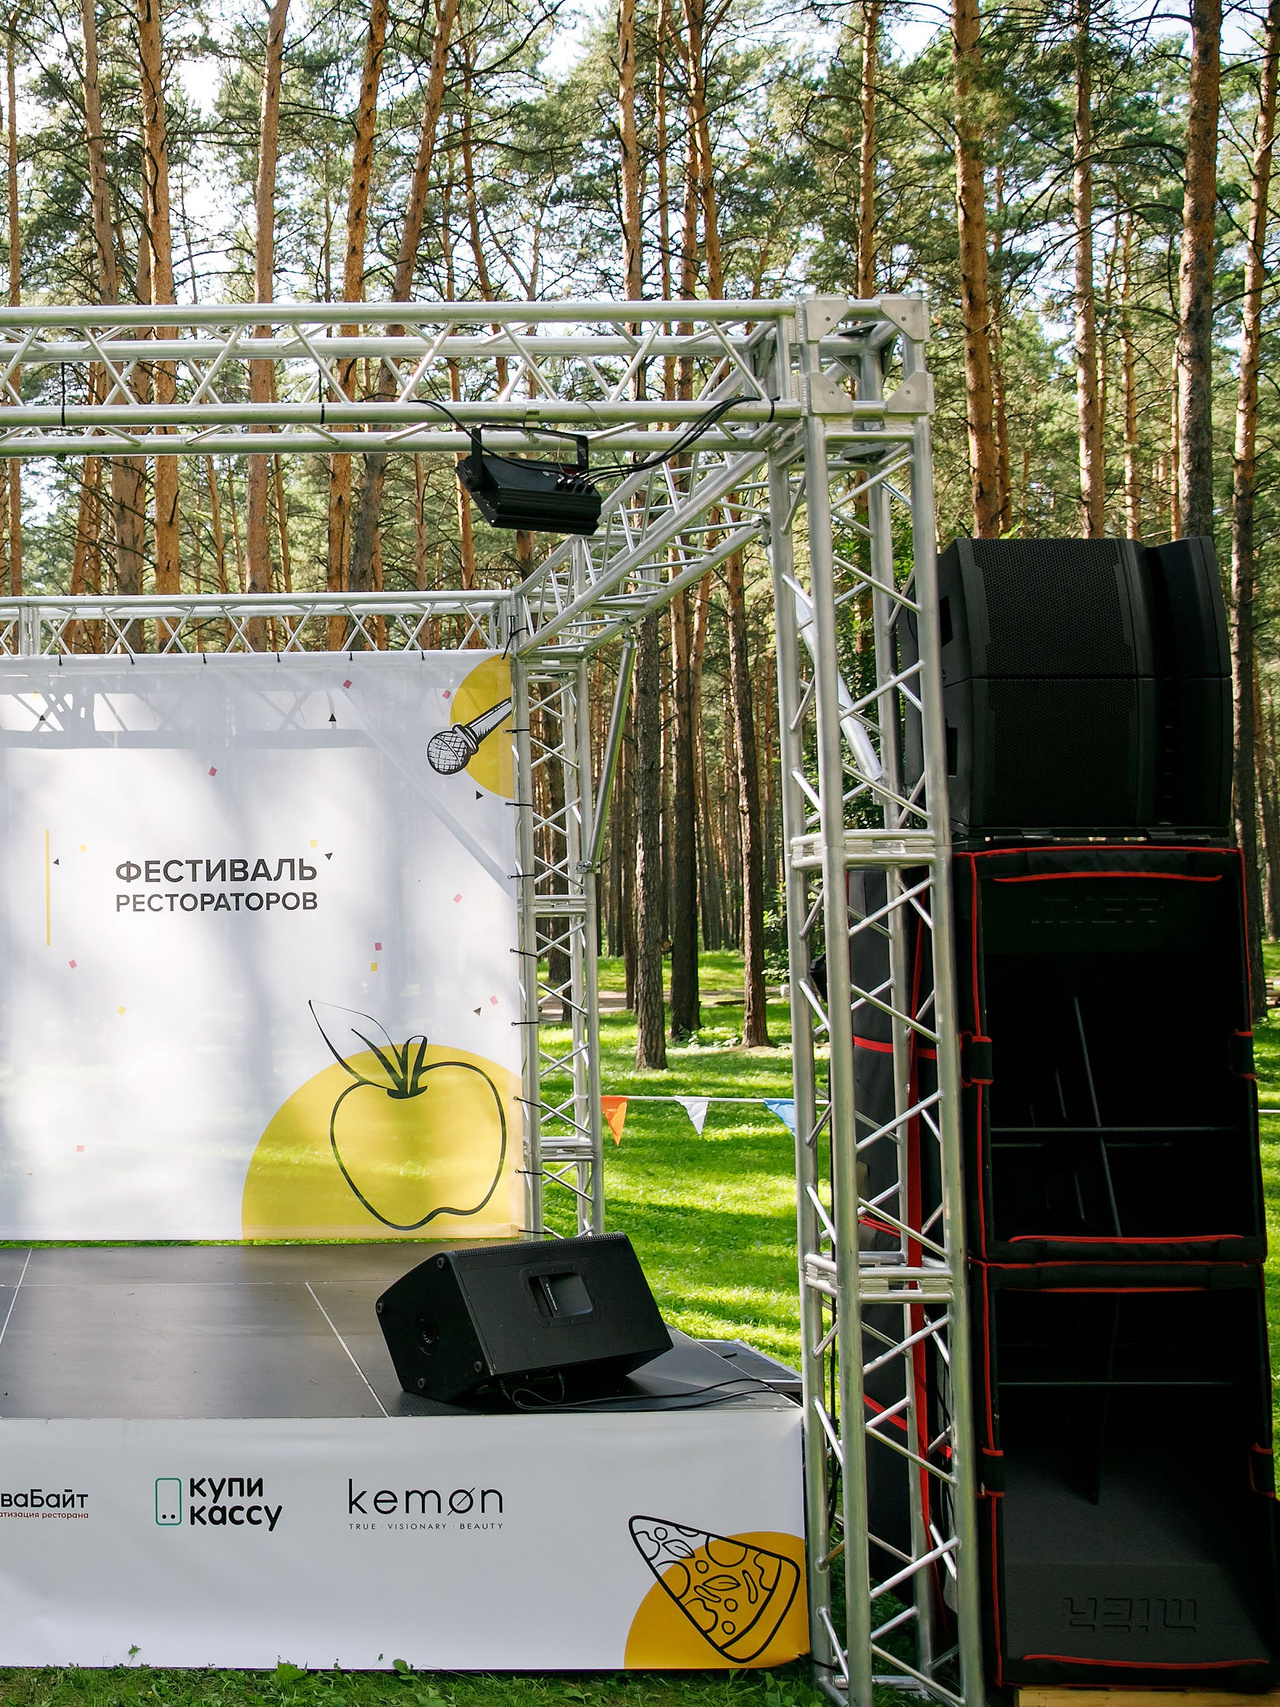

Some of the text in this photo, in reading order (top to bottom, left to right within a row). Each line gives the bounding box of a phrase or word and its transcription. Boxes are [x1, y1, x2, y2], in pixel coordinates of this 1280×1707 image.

[115, 858, 318, 883] ФЕСТИВАЛЬ
[115, 892, 318, 912] РЕСТОРАТОРОВ
[189, 1476, 264, 1504] купи
[41, 1511, 89, 1520] ресторана
[189, 1503, 283, 1532] кассу
[348, 1522, 504, 1530] TRUE VISIONARY BEAUTY
